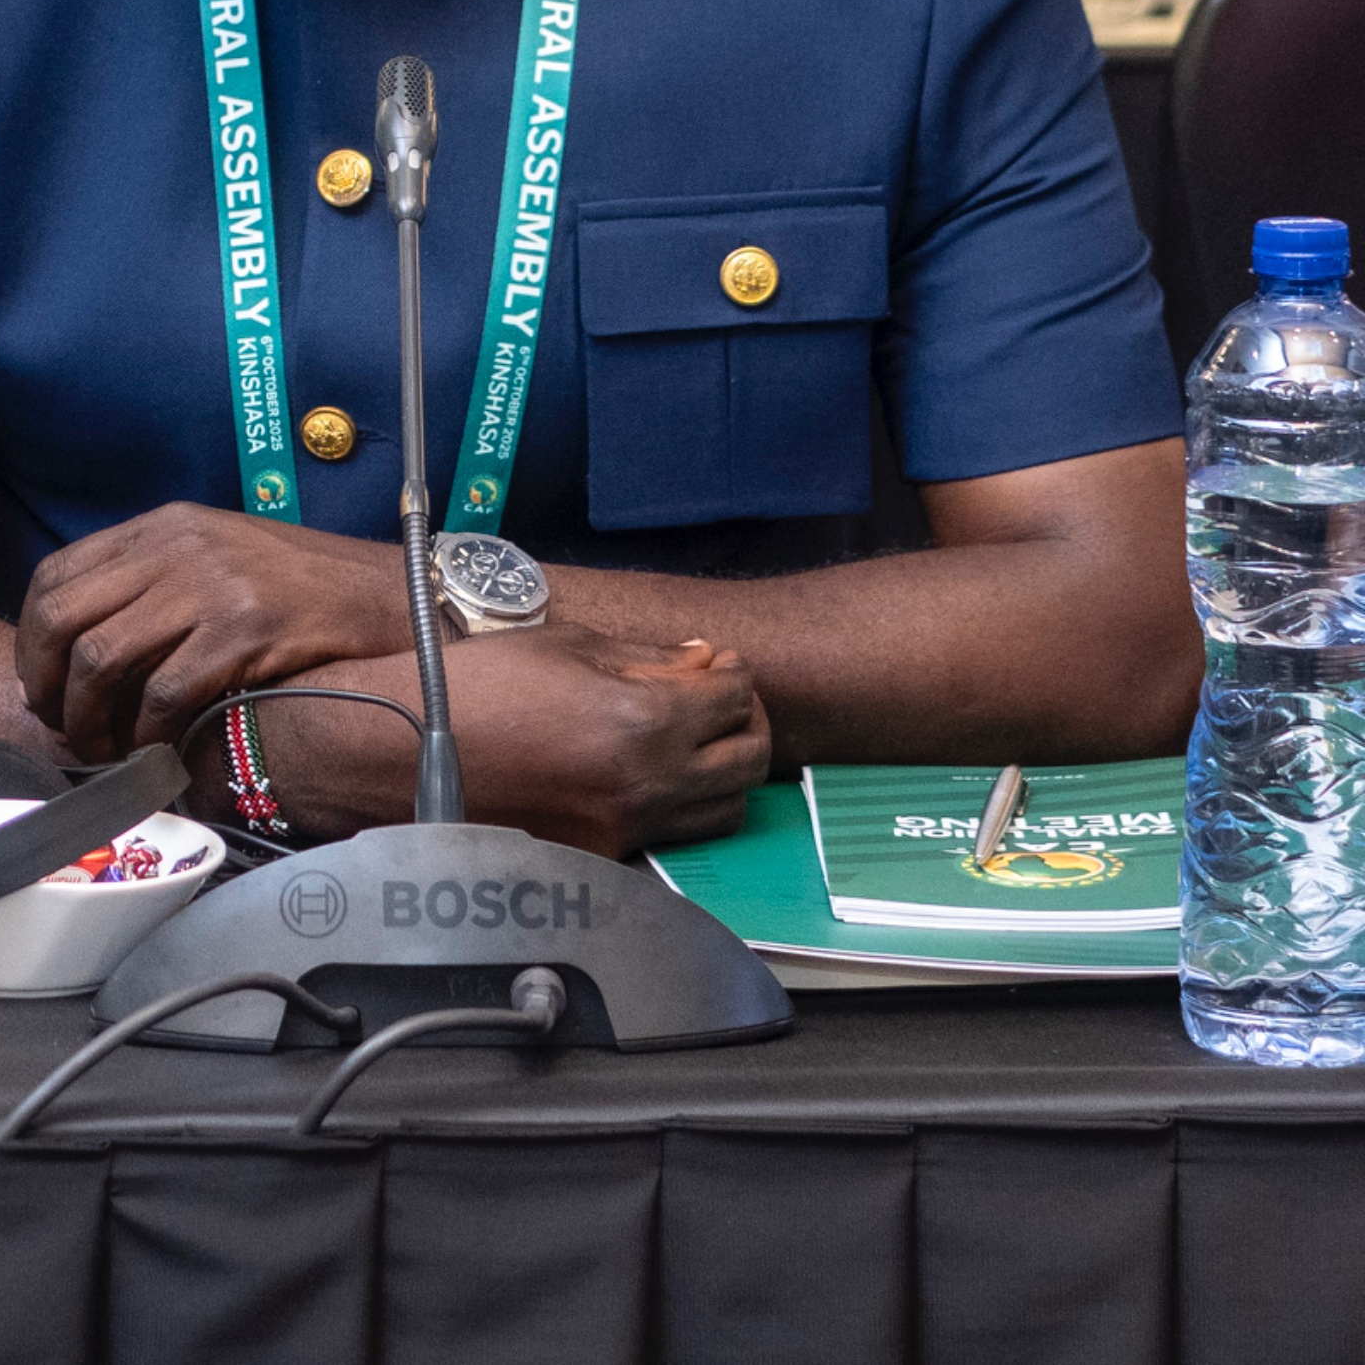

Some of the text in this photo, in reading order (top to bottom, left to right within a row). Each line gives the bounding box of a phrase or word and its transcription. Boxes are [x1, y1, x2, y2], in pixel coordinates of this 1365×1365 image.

[218, 95, 271, 327] ASSEMBLY
[503, 93, 565, 337] ASSEMBLY
[236, 337, 267, 454] KINSHASA
[262, 357, 280, 417] OCTOBER
[474, 342, 516, 455] KINSHASA
[505, 366, 527, 426] OCTOBER
[269, 419, 284, 451] 2025
[498, 427, 515, 460] 2025
[895, 812, 1174, 830] MEETNG
[1033, 824, 1177, 839] ZONAL
[381, 880, 591, 929] BOSCH
